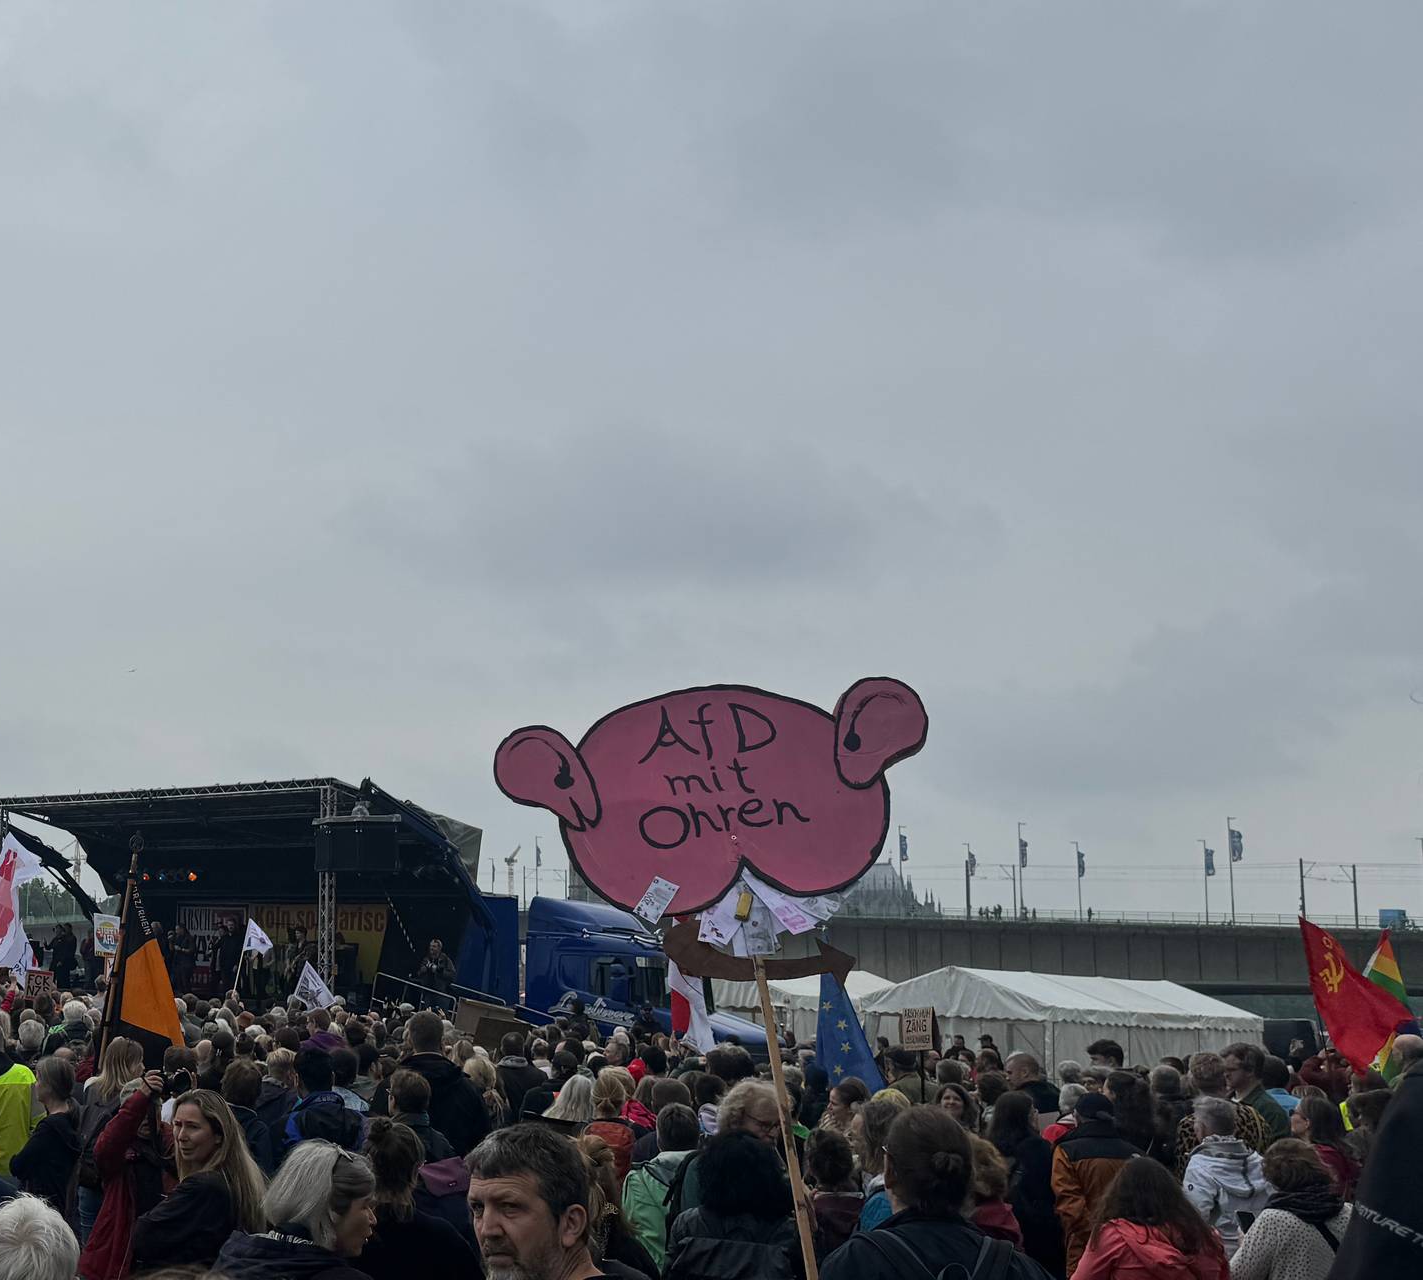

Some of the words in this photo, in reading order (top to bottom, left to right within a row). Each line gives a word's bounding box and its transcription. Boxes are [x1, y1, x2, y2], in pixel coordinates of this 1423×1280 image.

[638, 702, 777, 764] AfD
[664, 758, 756, 795] mit
[638, 797, 811, 849] Ohren
[27, 974, 50, 986] FCK
